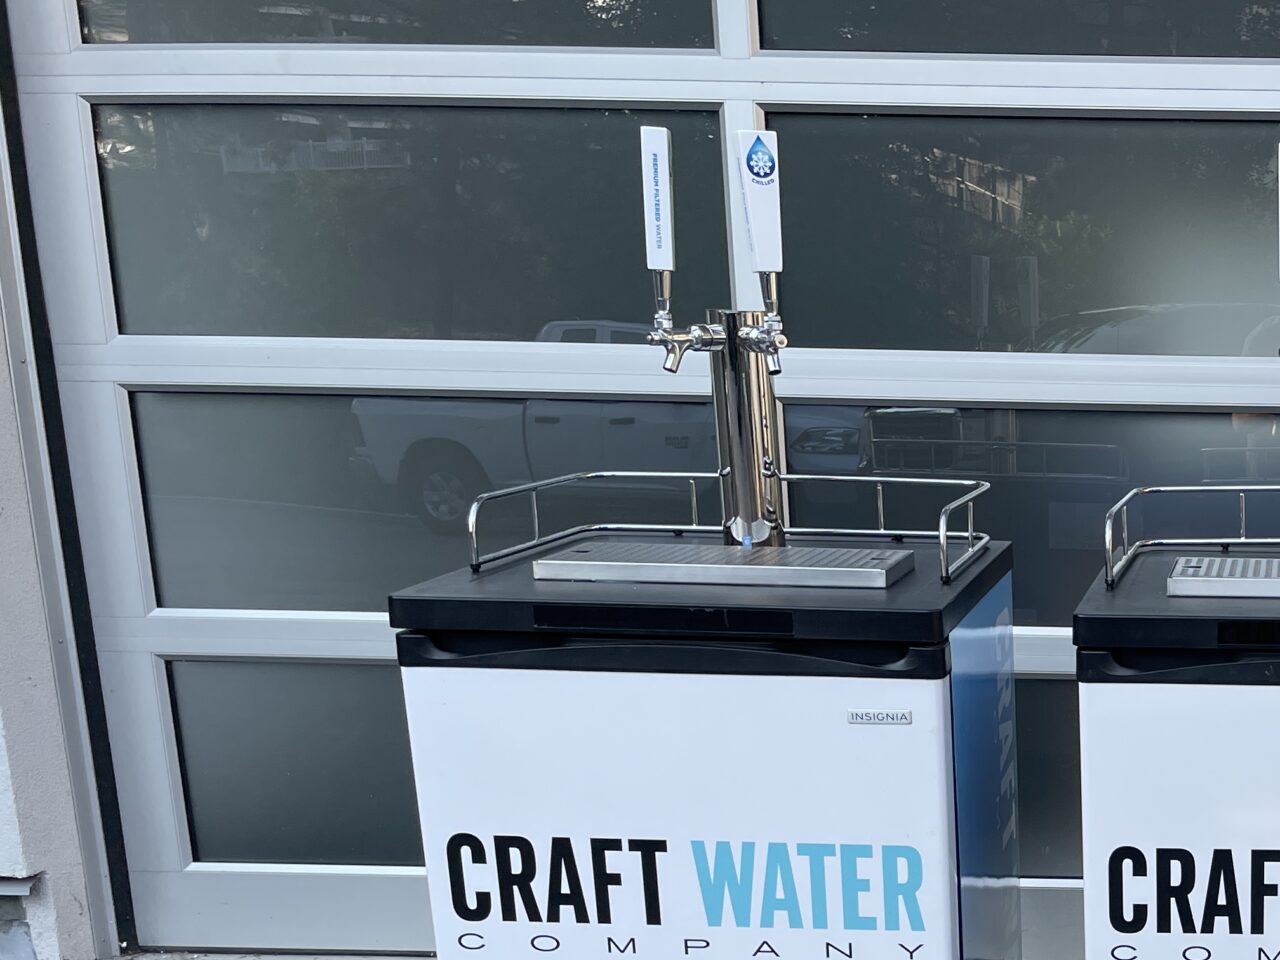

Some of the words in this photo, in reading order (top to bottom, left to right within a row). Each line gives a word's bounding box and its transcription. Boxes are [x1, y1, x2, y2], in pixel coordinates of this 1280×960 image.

[751, 177, 775, 187] CHILLED
[851, 712, 908, 721] INSIGNIA
[446, 832, 668, 925] CRAFT
[690, 839, 926, 931] WATER
[457, 932, 925, 960] COMPANY
